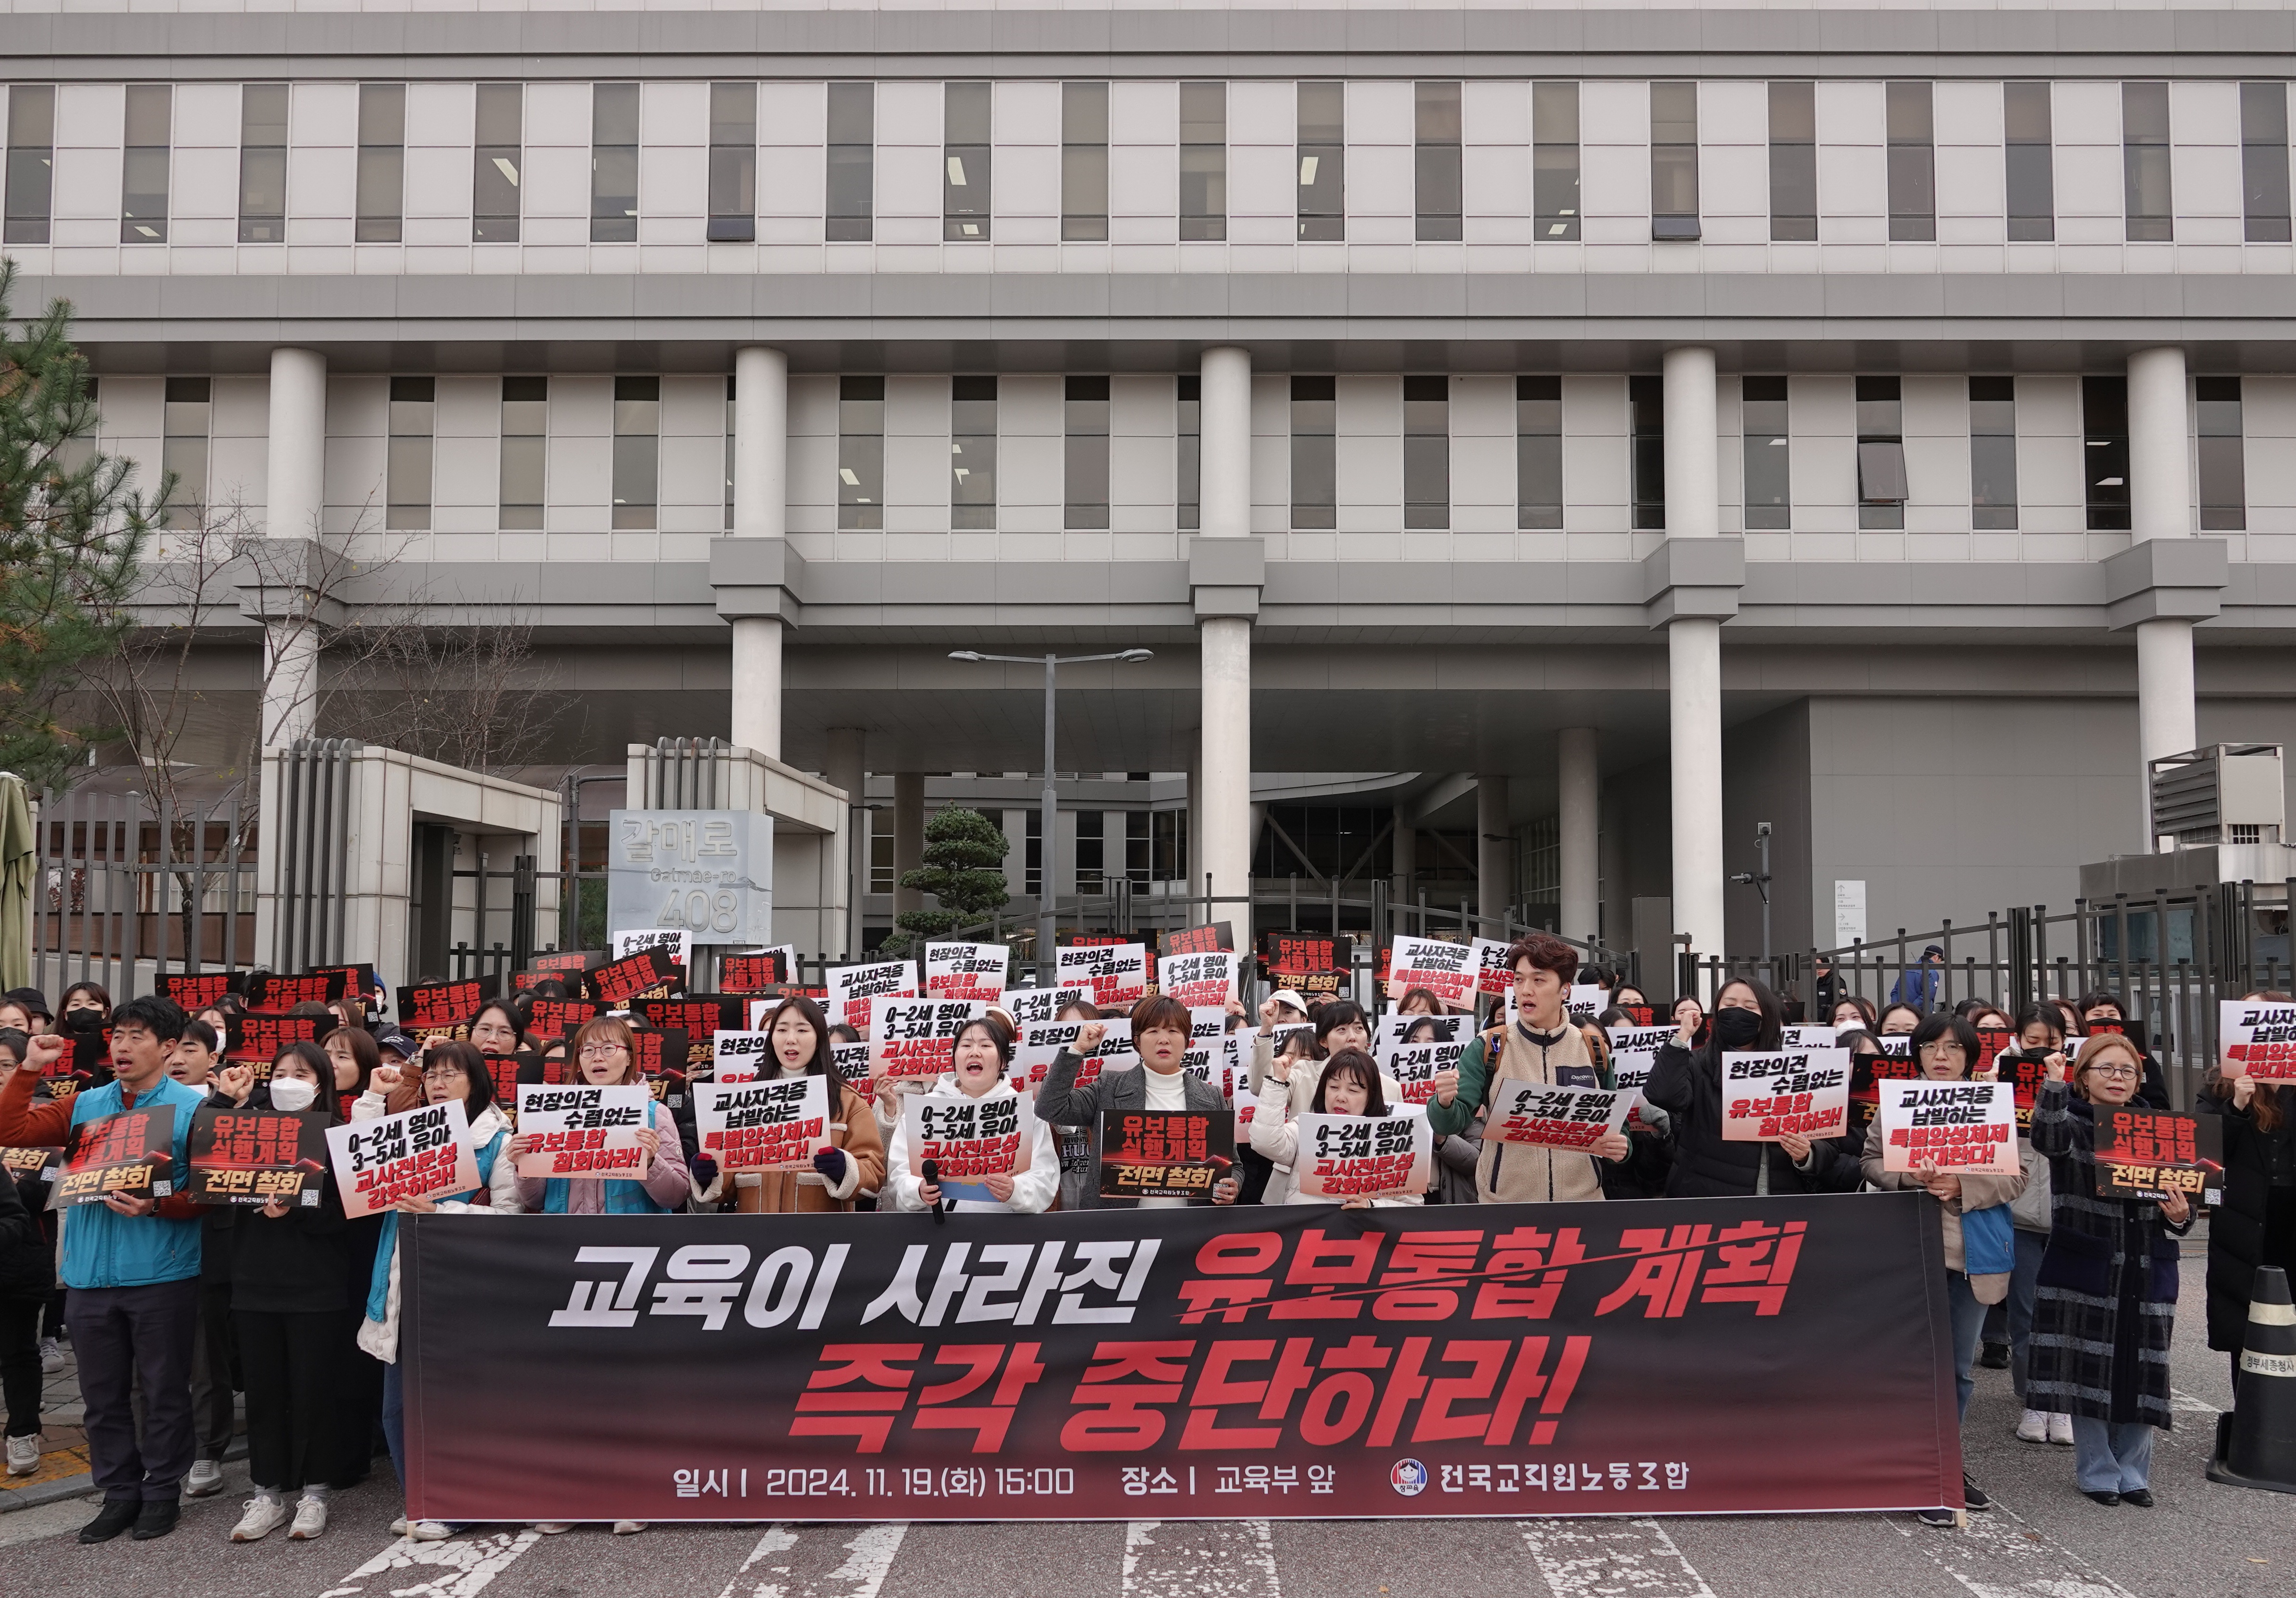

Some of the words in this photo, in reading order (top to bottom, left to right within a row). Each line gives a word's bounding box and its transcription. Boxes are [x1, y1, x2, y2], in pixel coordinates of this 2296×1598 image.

[621, 820, 737, 862] 갈매로
[657, 889, 738, 933] 408
[623, 934, 656, 947] 0-2세
[659, 932, 681, 944] 영아
[1169, 927, 1217, 947] 유보통합
[1279, 939, 1334, 956] 유보통합
[929, 946, 977, 962] 현장의견
[1061, 948, 1114, 966] 현장의견
[1279, 955, 1334, 972] 실행계획
[1405, 944, 1469, 960] 교사자격증
[595, 954, 651, 986] 유보통합
[725, 957, 775, 973] 유보통합
[840, 964, 904, 988] 교사자격증
[950, 959, 1003, 972] 수렴없는
[1089, 958, 1141, 976] 수렴없는
[1168, 957, 1200, 974] 0-2세
[1203, 955, 1227, 968] 영아
[1411, 957, 1462, 972] 남발하는
[167, 976, 229, 992] 유보통합
[265, 977, 329, 995] 유보통합
[600, 969, 658, 1002] 실행계획
[725, 972, 775, 988] 실행계획
[929, 973, 978, 990] 유보통합
[1168, 969, 1200, 987] 3-5세
[1203, 967, 1228, 980] 유아
[1278, 975, 1307, 990] 전면
[1307, 975, 1340, 991] 철회
[1394, 969, 1475, 988] 특별양성체제
[413, 983, 481, 1006] 유보통합
[849, 979, 899, 999] 남발하는
[1094, 986, 1143, 1006] 회하라!
[1169, 979, 1230, 999] 교사전문성
[414, 1000, 481, 1023] 실행계획
[532, 1000, 596, 1024] 유보통합
[647, 1003, 721, 1022] 유보통합
[885, 1005, 934, 1023] 0-2세
[937, 1003, 971, 1020] 영아
[1013, 993, 1051, 1012] 0-2세
[1015, 1007, 1052, 1026] 3-5세
[2239, 1009, 2296, 1026] 교사자
[241, 1019, 316, 1038] 유보통합
[884, 1023, 933, 1040] 3-5세
[881, 1038, 954, 1058] 교사전문
[1390, 1048, 1431, 1068] 0-2세
[1393, 1064, 1432, 1082] 3-5세
[1729, 1054, 1808, 1079] 현장의견
[1771, 1069, 1844, 1095] 수렴없는
[524, 1089, 603, 1113] 현장의견
[713, 1080, 808, 1112] 교사자격증
[1515, 1090, 1575, 1107] 0-2세
[1575, 1093, 1617, 1108] 영아
[1729, 1092, 1813, 1118] 유보통합
[1899, 1085, 1994, 1108] 교사자격증
[564, 1107, 642, 1129] 수렴없는
[725, 1104, 800, 1129] 남발하는
[921, 1105, 975, 1123] 0-2세
[979, 1097, 1018, 1120] 영아
[1509, 1103, 1570, 1120] 3-5세
[1570, 1108, 1612, 1123] 유아
[1758, 1106, 1843, 1136] 철회하라!
[1911, 1106, 1986, 1126] 남발하는
[79, 1113, 150, 1142] 유보통합
[212, 1116, 303, 1141] 유보통합
[348, 1120, 403, 1153] 0-2세
[408, 1106, 447, 1134] 영아
[704, 1117, 824, 1150] 특별양성체제
[921, 1122, 976, 1140] 3-5세
[979, 1115, 1018, 1138] 유아
[1122, 1116, 1209, 1140] 유보통합
[1316, 1123, 1371, 1142] 0-2세
[1375, 1119, 1414, 1139] 영아
[1501, 1116, 1609, 1137] 교사전문성
[1889, 1124, 2009, 1148] 특별양성체제
[2112, 1112, 2197, 1141] 유보통합
[352, 1138, 407, 1172] 3-5세
[412, 1125, 452, 1153] 유아
[524, 1129, 607, 1154] 유보통합
[920, 1131, 1021, 1158] 교사전문성
[1121, 1138, 1207, 1161] 실행계획
[1315, 1141, 1371, 1158] 3-5세
[1375, 1136, 1414, 1156] 유아
[1504, 1129, 1597, 1148] 강화하라!
[2112, 1135, 2196, 1163] 실행계획
[3, 1149, 51, 1171] 철회
[70, 1136, 145, 1166] 실행계획
[211, 1140, 299, 1165] 실행계획
[552, 1147, 642, 1173] 철회하라!
[724, 1141, 809, 1168] 반대한다!
[1908, 1145, 1995, 1168] 반대한다!
[355, 1142, 457, 1193] 교사전문성
[934, 1152, 1016, 1177] 강화하라!
[1313, 1152, 1416, 1177] 교사전문성
[59, 1169, 104, 1197] 전면
[102, 1165, 155, 1191] 철회
[205, 1169, 256, 1193] 전면
[255, 1170, 305, 1195] 철회
[367, 1164, 456, 1209] 강화하라!
[1117, 1165, 1166, 1187] 전면
[1166, 1167, 1216, 1189] 철회
[1321, 1171, 1409, 1195] 강화하라!
[2110, 1164, 2157, 1189] 전면
[2158, 1167, 2206, 1194] 철회
[548, 1243, 851, 1330] 교육이
[860, 1239, 1162, 1327] 사라진
[1176, 1227, 1584, 1324] 유보통합
[1594, 1220, 1808, 1318] 계획
[2246, 1355, 2295, 1372] 정부세종청사
[788, 1342, 1045, 1453] 즉각
[1060, 1336, 1592, 1451] 중단하라!
[673, 1469, 728, 1497] 일시
[767, 1469, 856, 1497] 2024.
[866, 1469, 892, 1497] 11.
[995, 1468, 1073, 1495] 15:00
[1121, 1467, 1178, 1496] 장소
[1215, 1465, 1299, 1494] 교육부
[1308, 1465, 1335, 1494] 앞
[1441, 1462, 1689, 1492] 전국교직원노동조합
